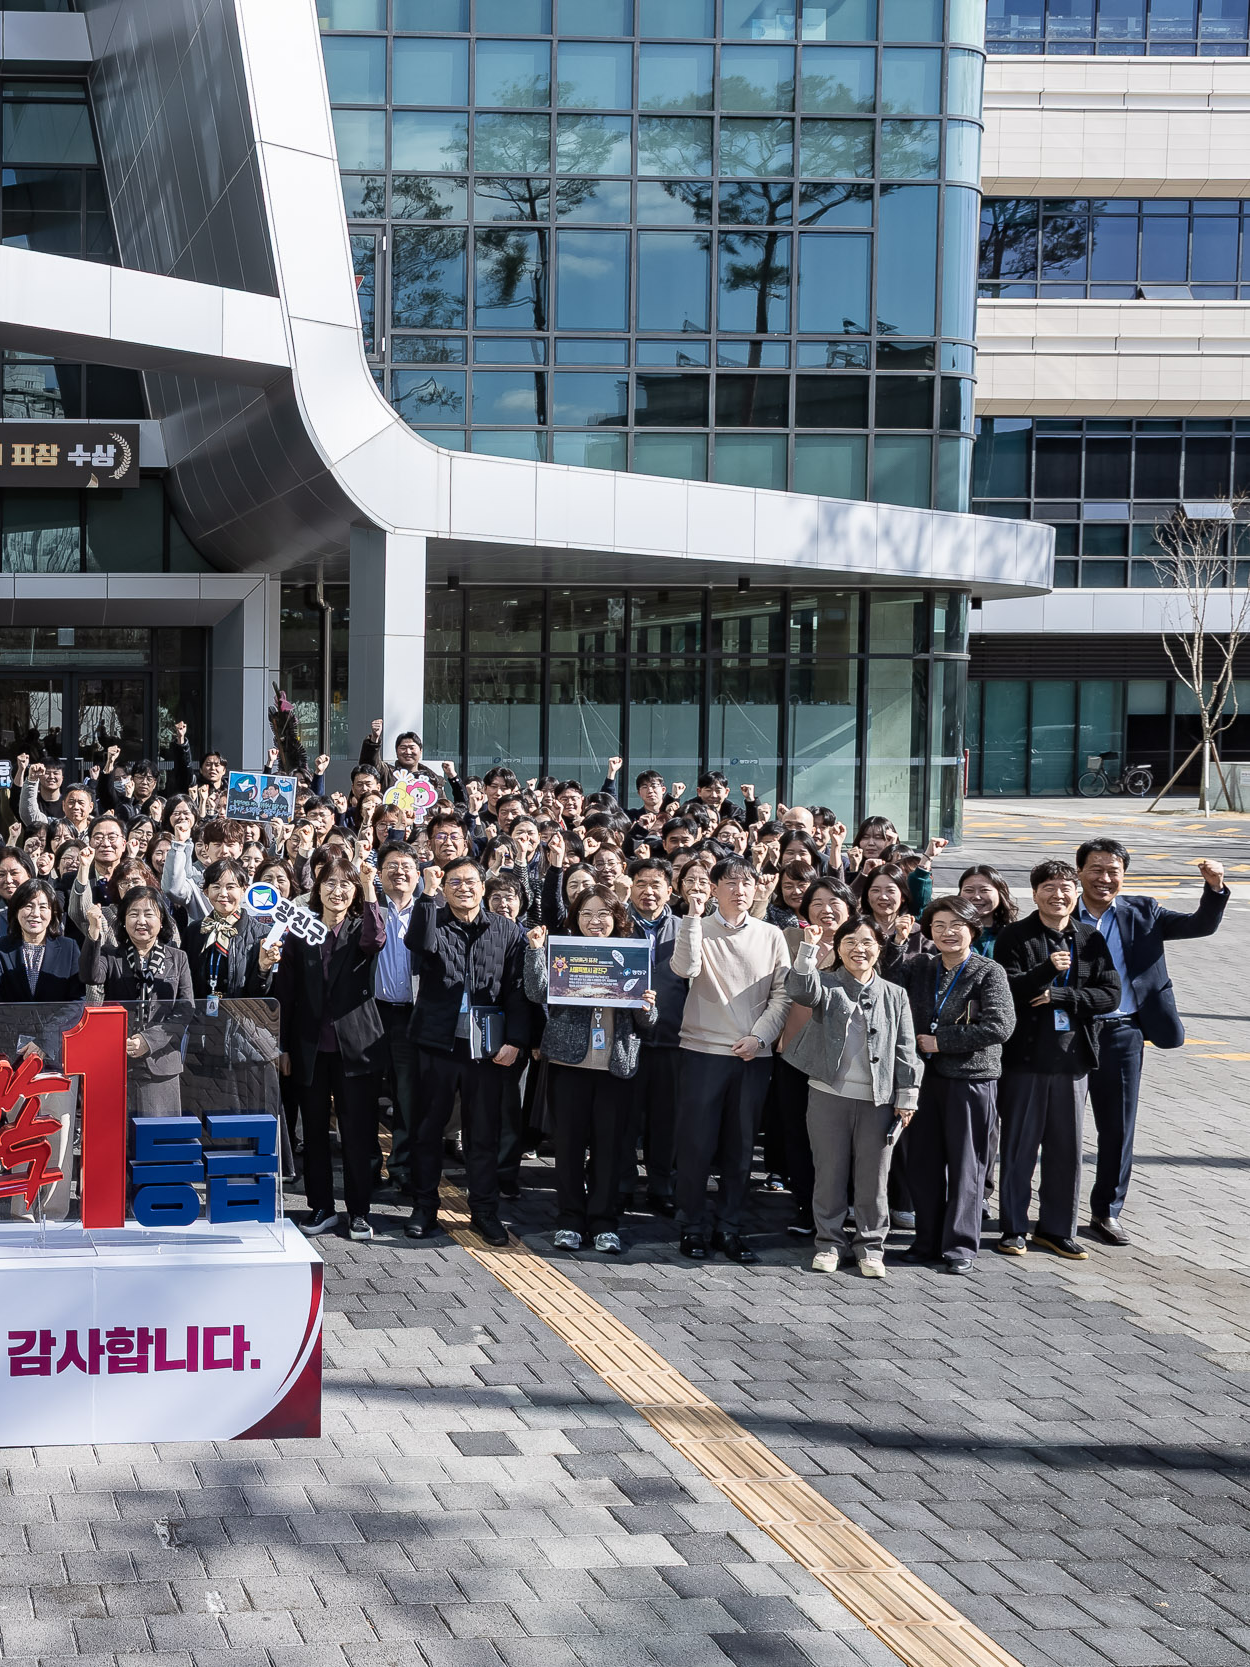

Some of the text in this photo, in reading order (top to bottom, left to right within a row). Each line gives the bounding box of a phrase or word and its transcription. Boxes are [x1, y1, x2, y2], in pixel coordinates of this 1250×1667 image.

[11, 443, 60, 466] 표창
[67, 443, 116, 467] 수상
[275, 901, 324, 942] 광진구
[7, 1325, 261, 1377] 감사합니다.
